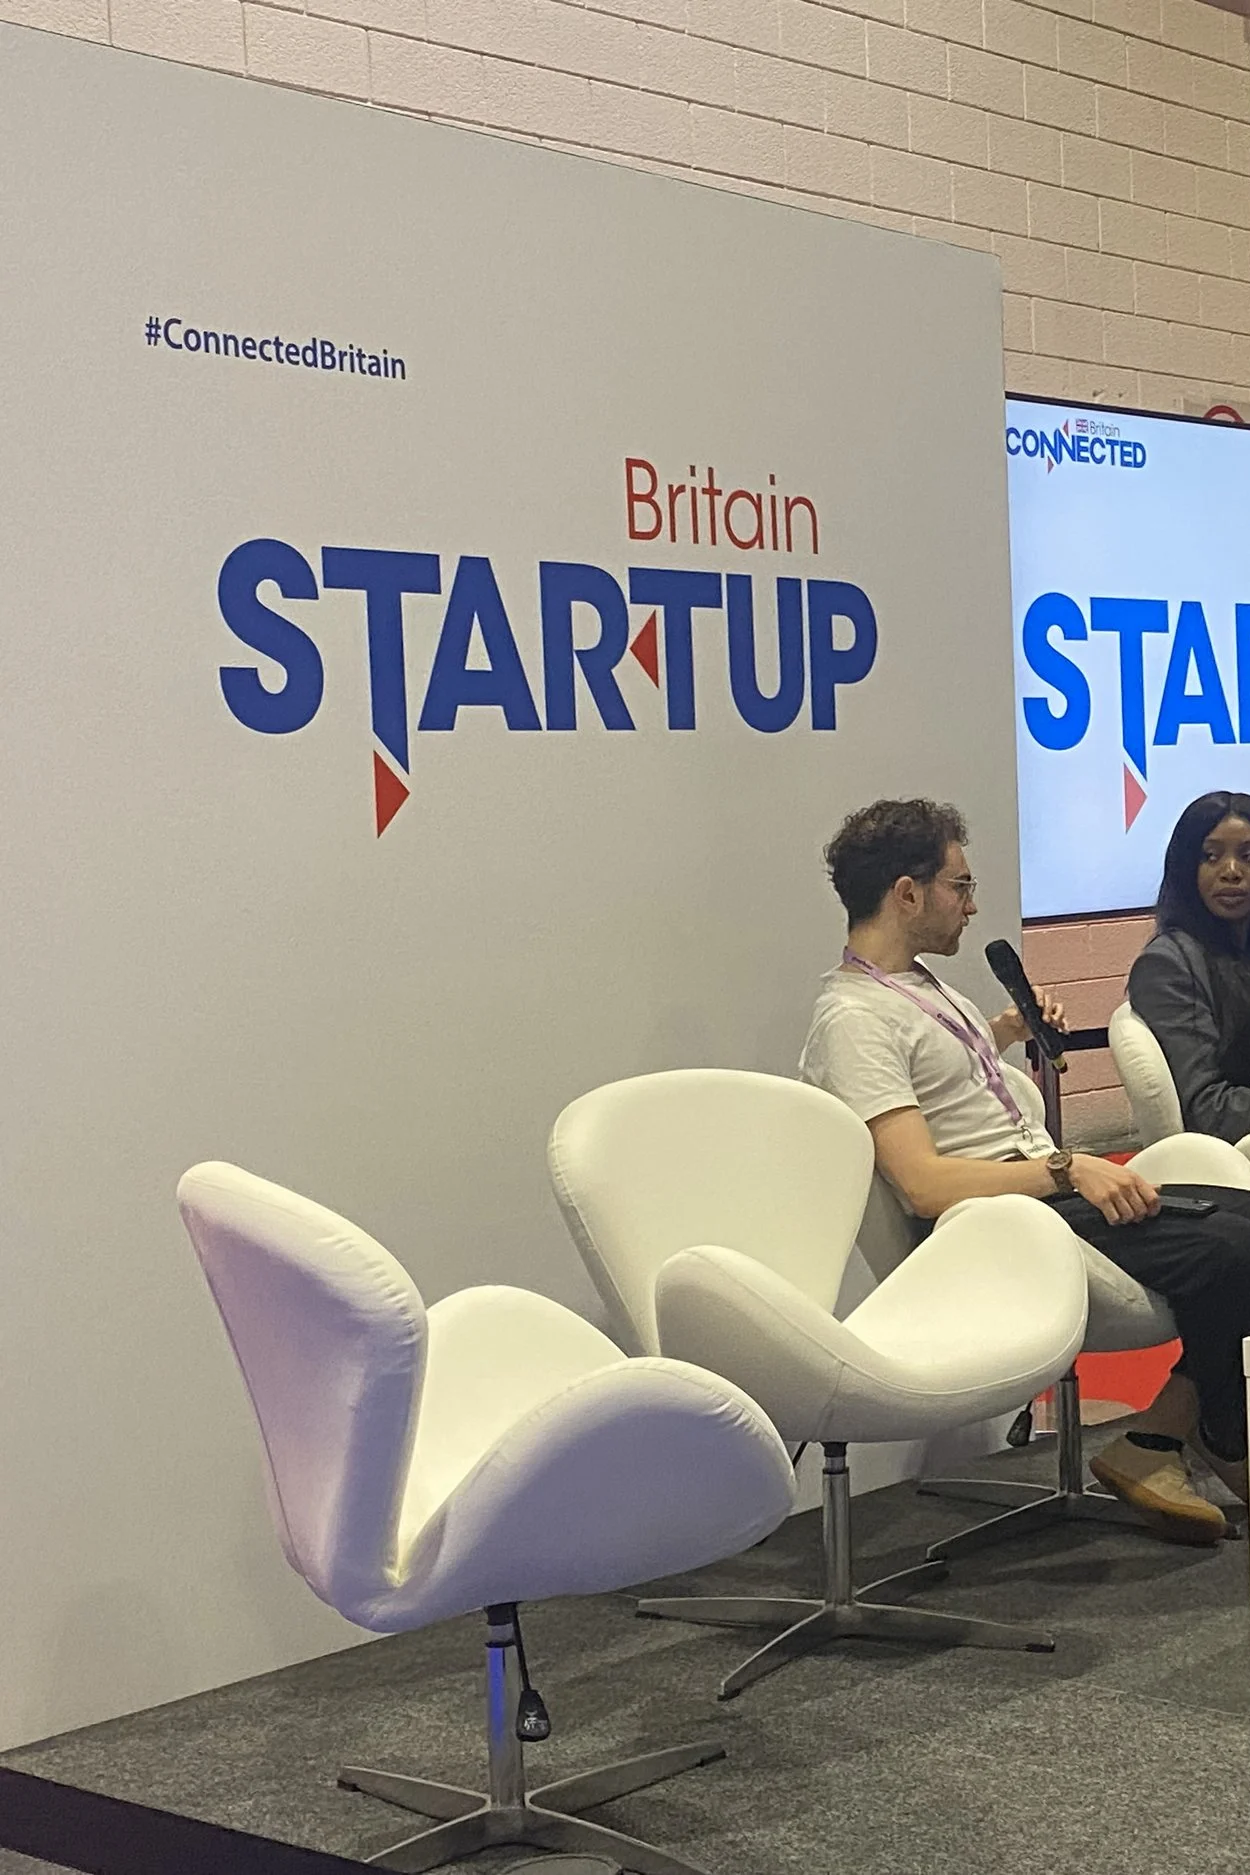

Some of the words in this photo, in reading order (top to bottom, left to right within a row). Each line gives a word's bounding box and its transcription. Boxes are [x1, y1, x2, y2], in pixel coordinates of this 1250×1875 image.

[145, 316, 406, 380] #ConnectedBritain
[1006, 427, 1147, 469] CONNECTED
[1089, 421, 1120, 438] Britain
[625, 457, 819, 556] Britain
[217, 538, 879, 776] STARTUP
